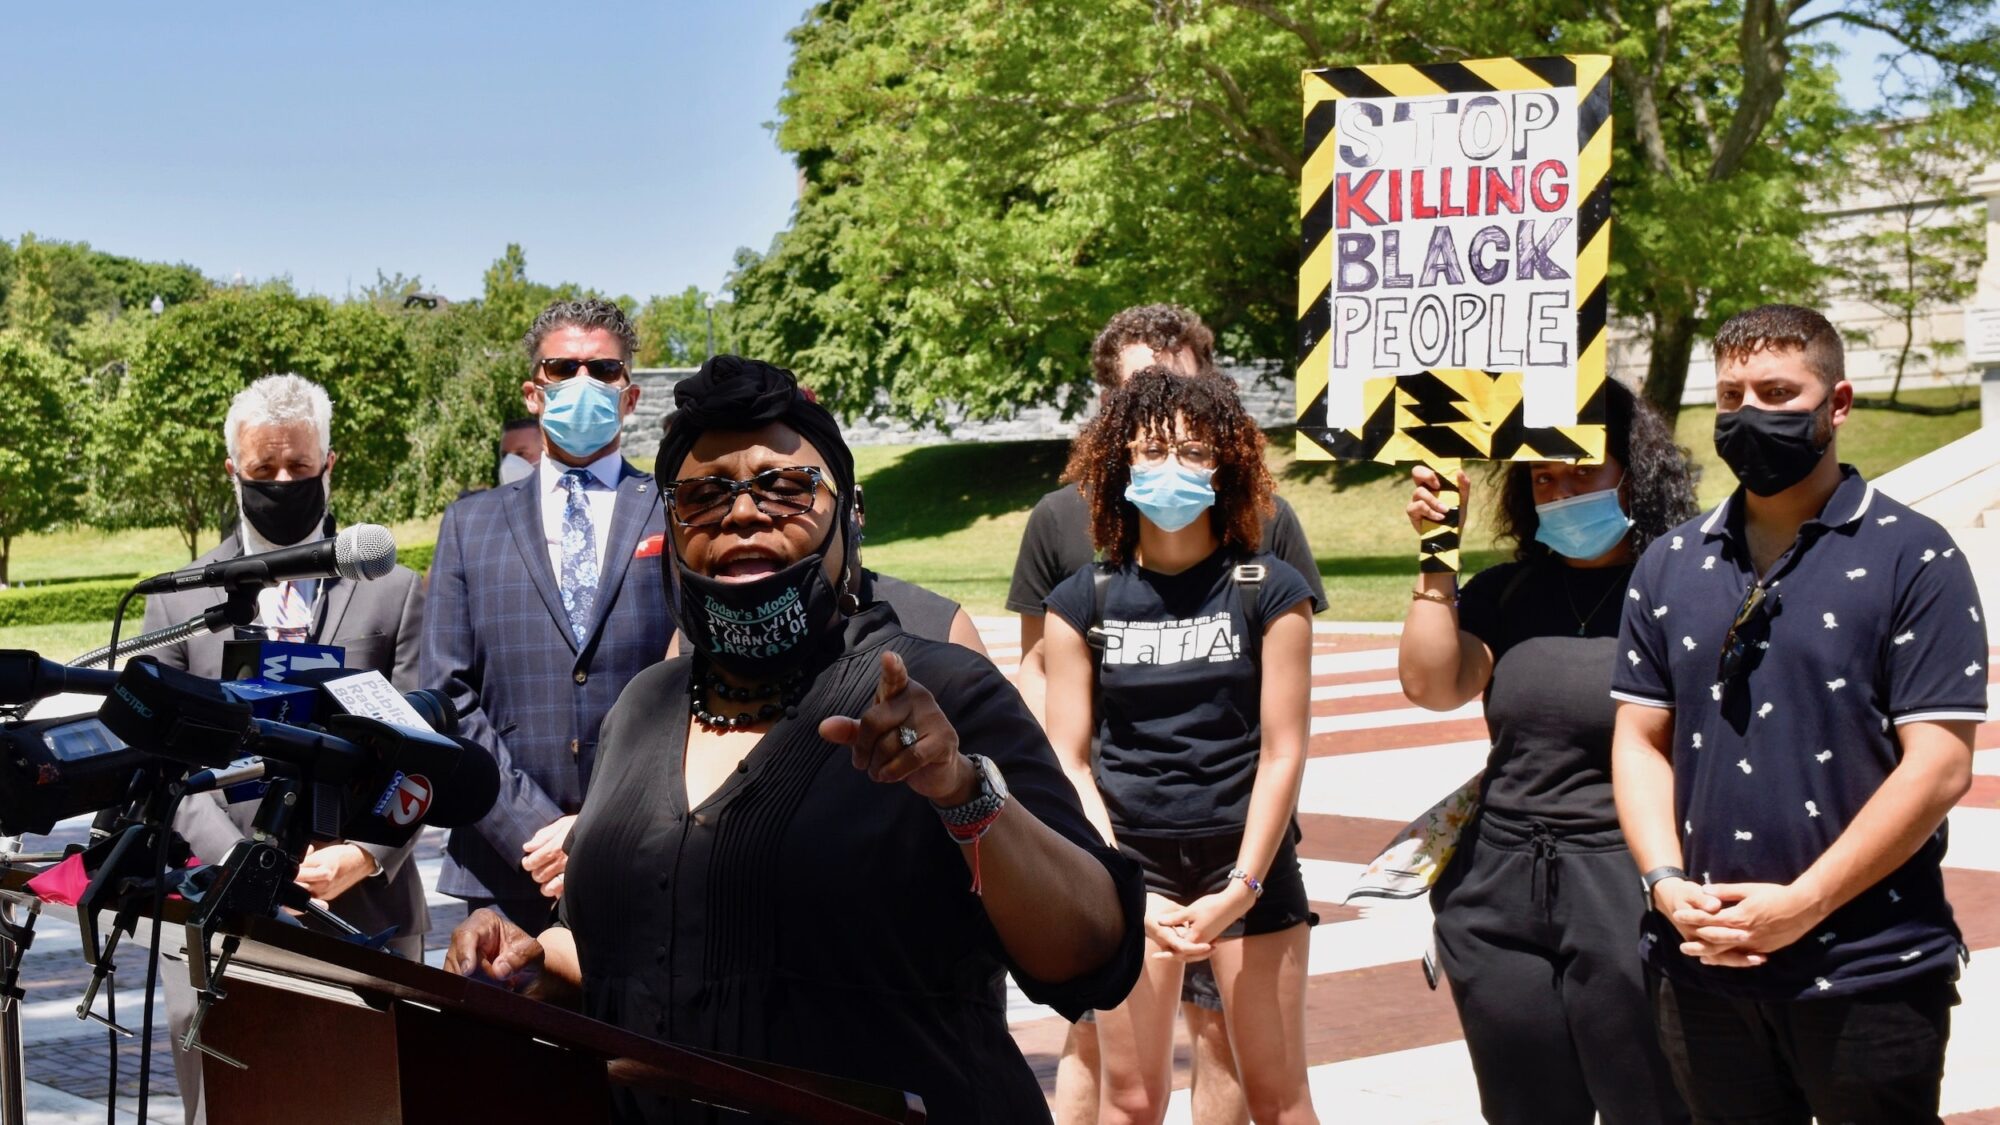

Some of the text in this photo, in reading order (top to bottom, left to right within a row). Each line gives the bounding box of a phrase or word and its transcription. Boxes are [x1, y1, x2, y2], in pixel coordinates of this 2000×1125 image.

[1339, 92, 1559, 168] STOP
[1335, 159, 1569, 229] KILLING
[1337, 217, 1573, 293] BLACK
[1333, 290, 1570, 369] PEOPLE
[704, 586, 800, 621] Today's Mood:
[724, 629, 781, 646] CHANCE
[790, 613, 808, 634] OF
[382, 776, 429, 825] 12
